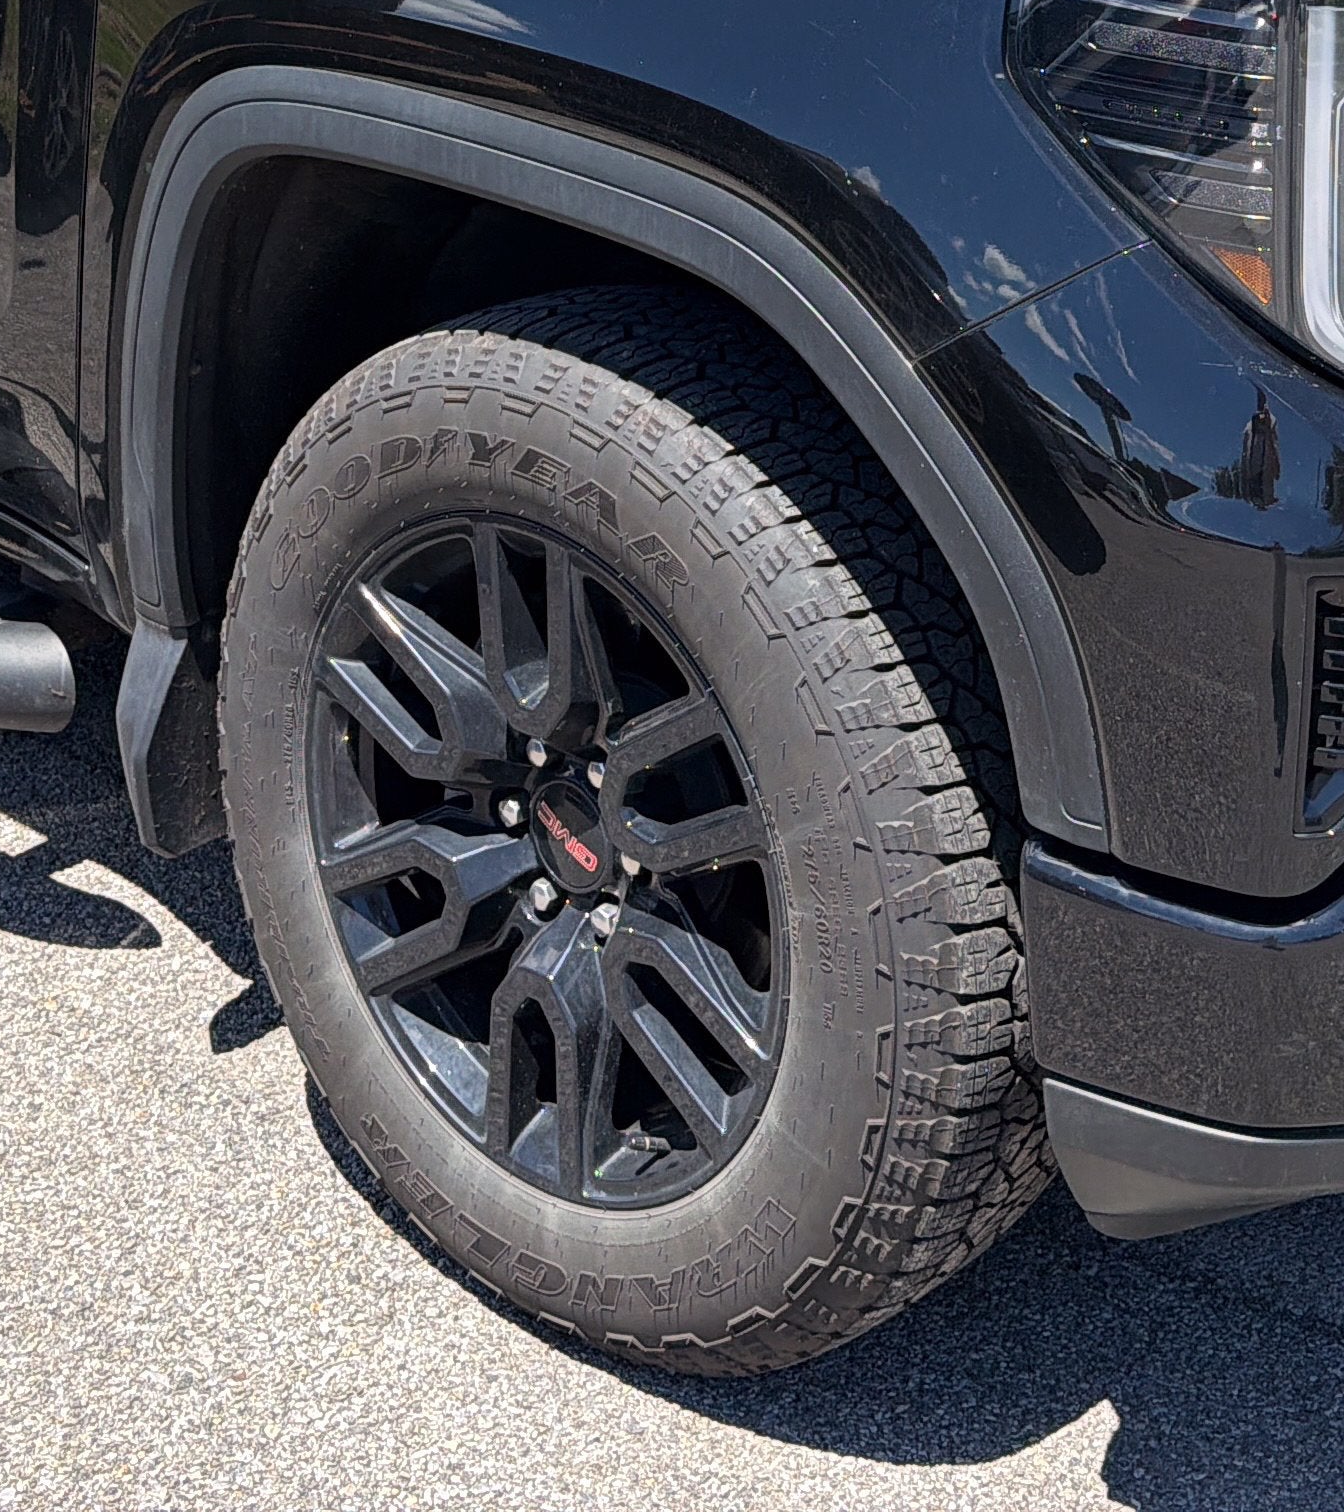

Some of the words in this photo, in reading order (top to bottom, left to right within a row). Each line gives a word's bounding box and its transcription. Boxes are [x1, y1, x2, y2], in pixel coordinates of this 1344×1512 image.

[269, 425, 692, 590] GOODYEAR
[537, 799, 598, 872] GMC
[359, 1113, 797, 1313] WRANGLER
